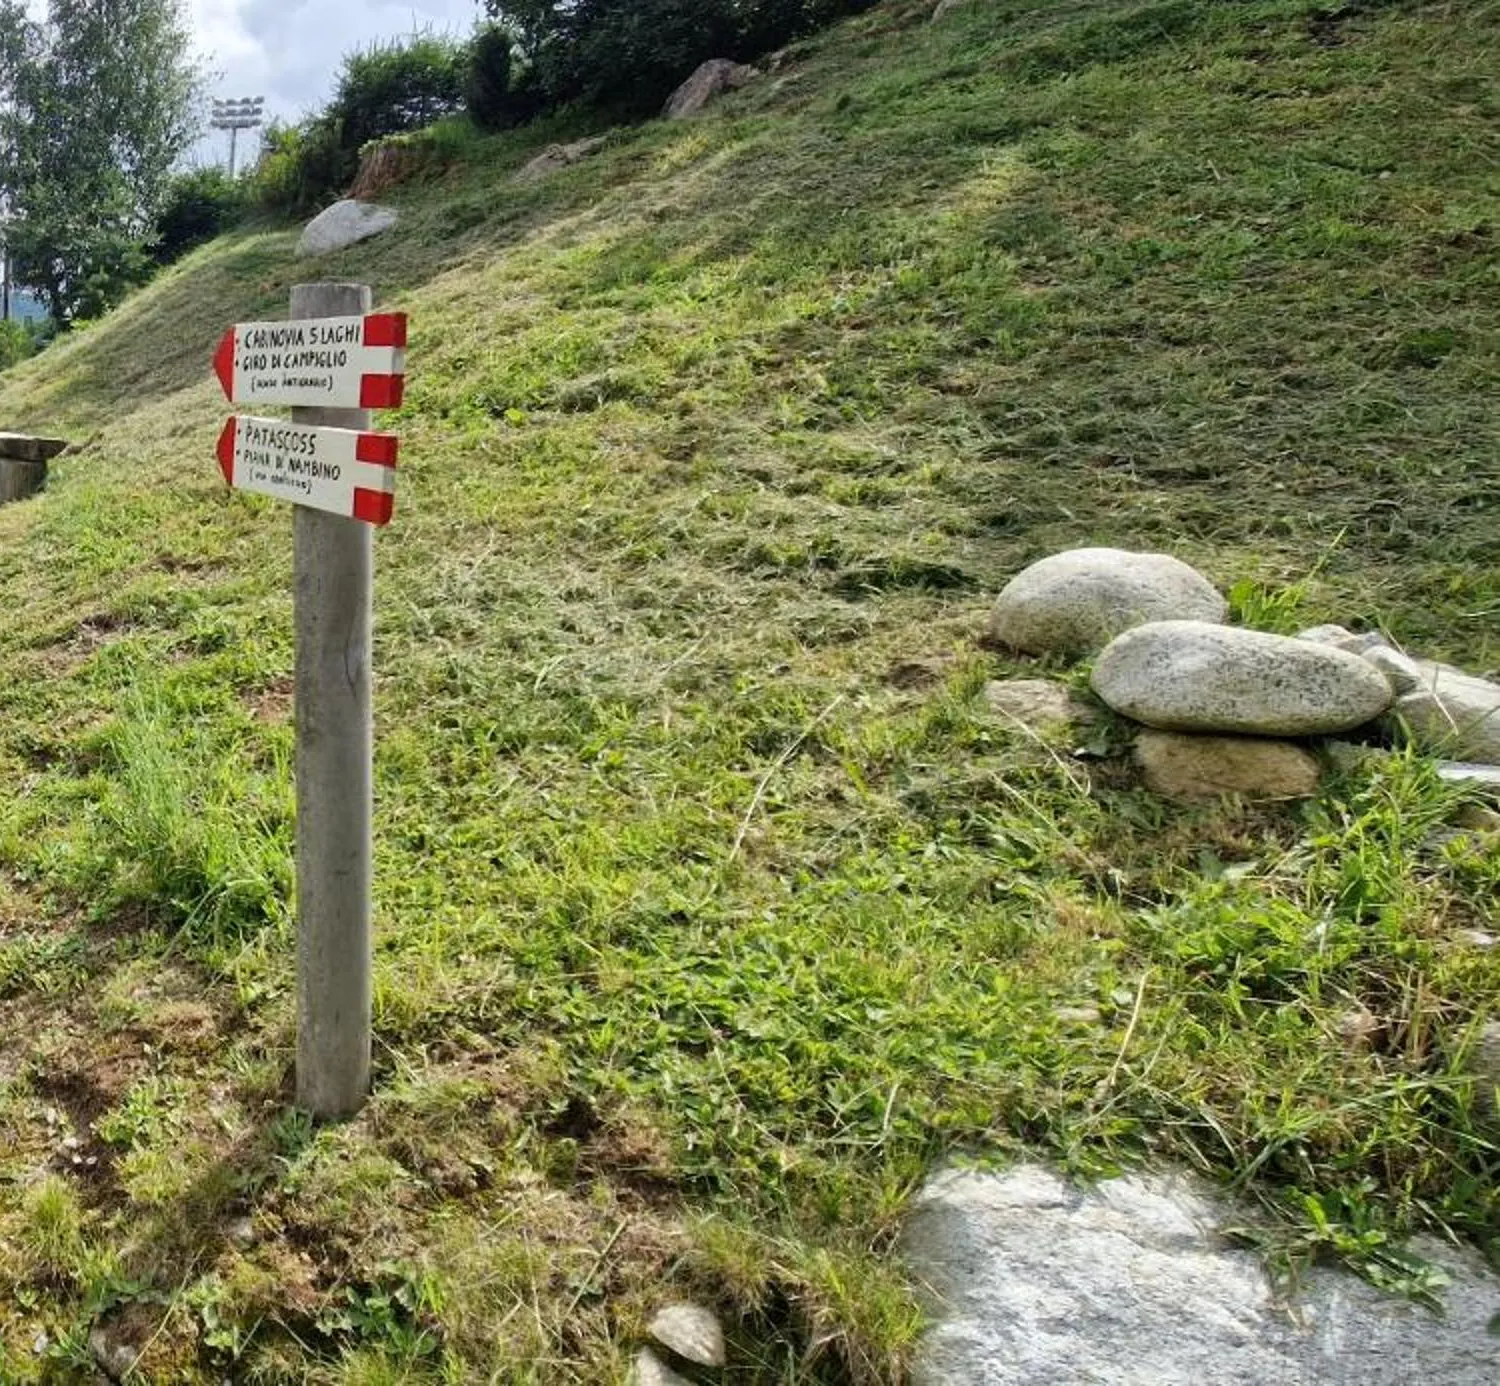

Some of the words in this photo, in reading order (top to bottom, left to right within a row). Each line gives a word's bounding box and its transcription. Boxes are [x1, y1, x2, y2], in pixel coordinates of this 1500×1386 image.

[321, 324, 360, 345] LAGHI
[243, 354, 267, 372] GIRO
[271, 354, 281, 369] DI
[283, 350, 347, 369] CAMPIGLIO
[245, 425, 317, 455] PATASCOSS
[243, 449, 270, 465] PIANA
[276, 454, 284, 469] DI
[288, 457, 341, 481] NAMBINO
